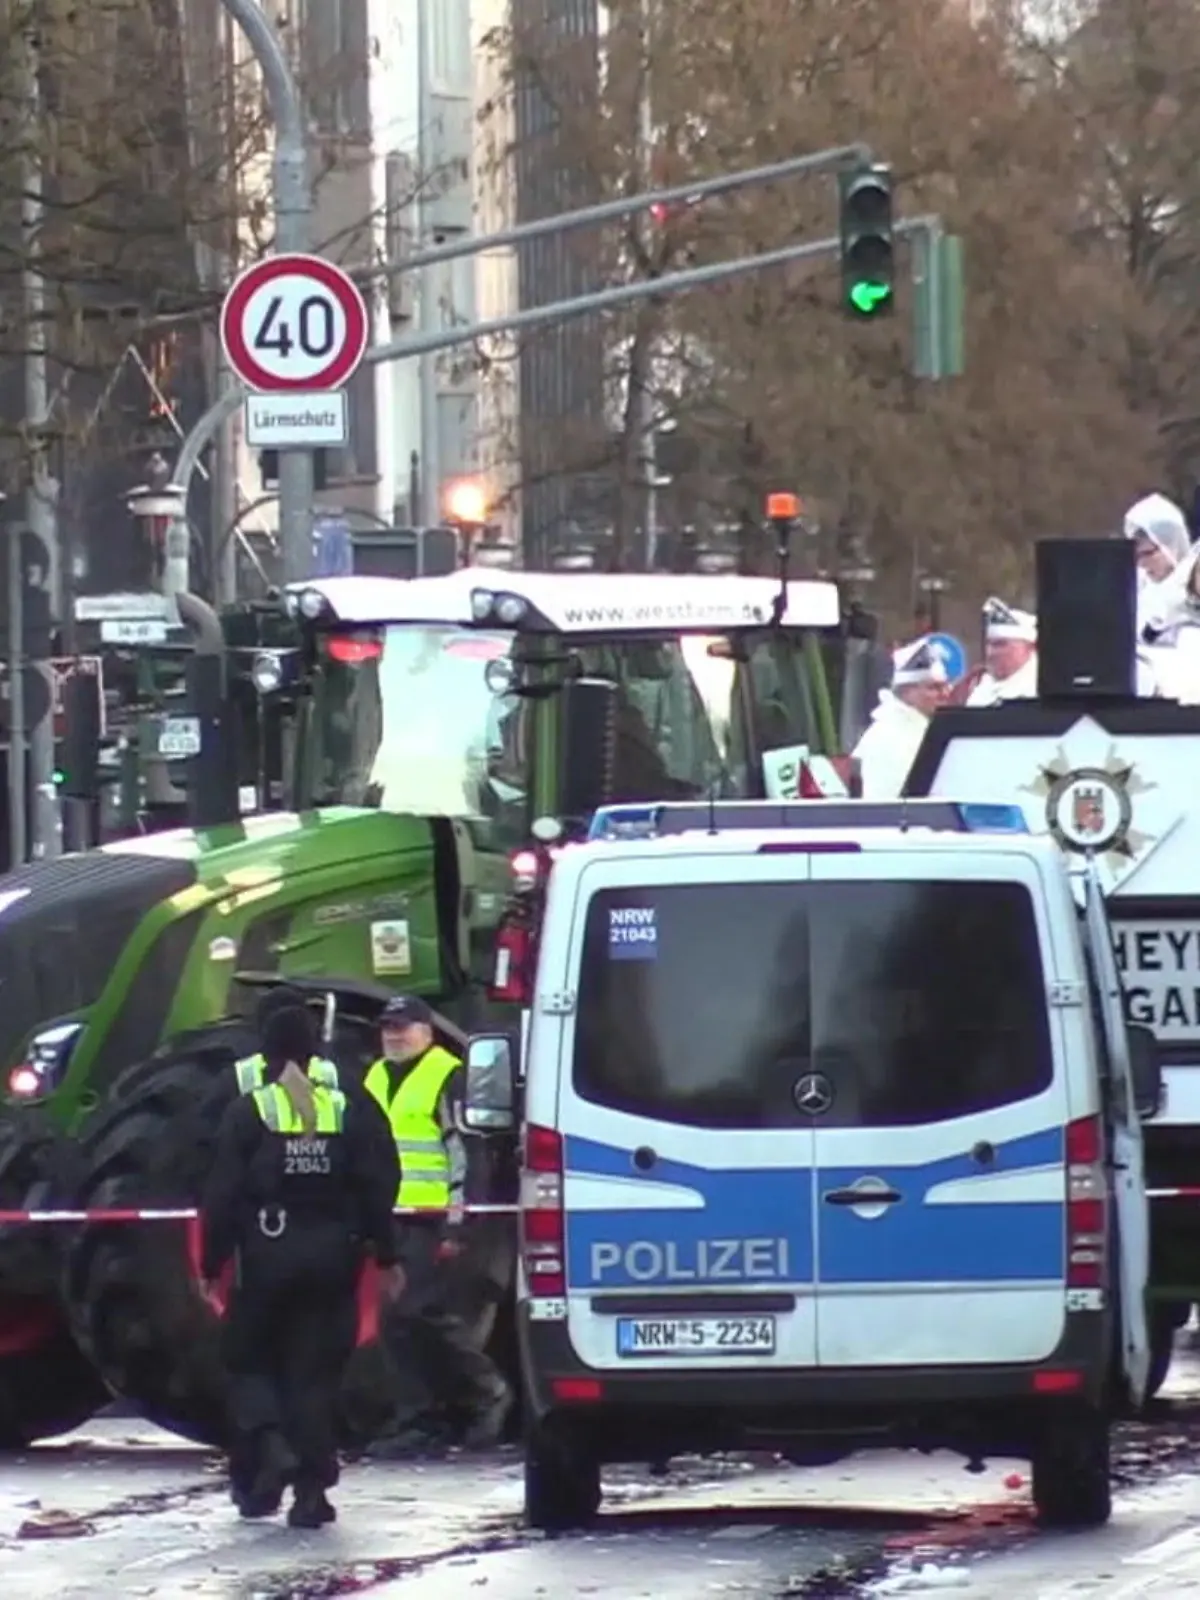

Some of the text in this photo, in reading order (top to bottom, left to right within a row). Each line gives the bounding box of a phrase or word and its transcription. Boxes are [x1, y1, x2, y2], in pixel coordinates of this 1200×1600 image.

[254, 295, 334, 358] 40
[254, 411, 337, 428] Lärmschutz
[610, 908, 655, 925] NRW
[610, 927, 657, 943] 21043
[285, 1139, 327, 1155] NRW
[284, 1156, 331, 1174] 21043
[590, 1238, 790, 1280] POLIZEI
